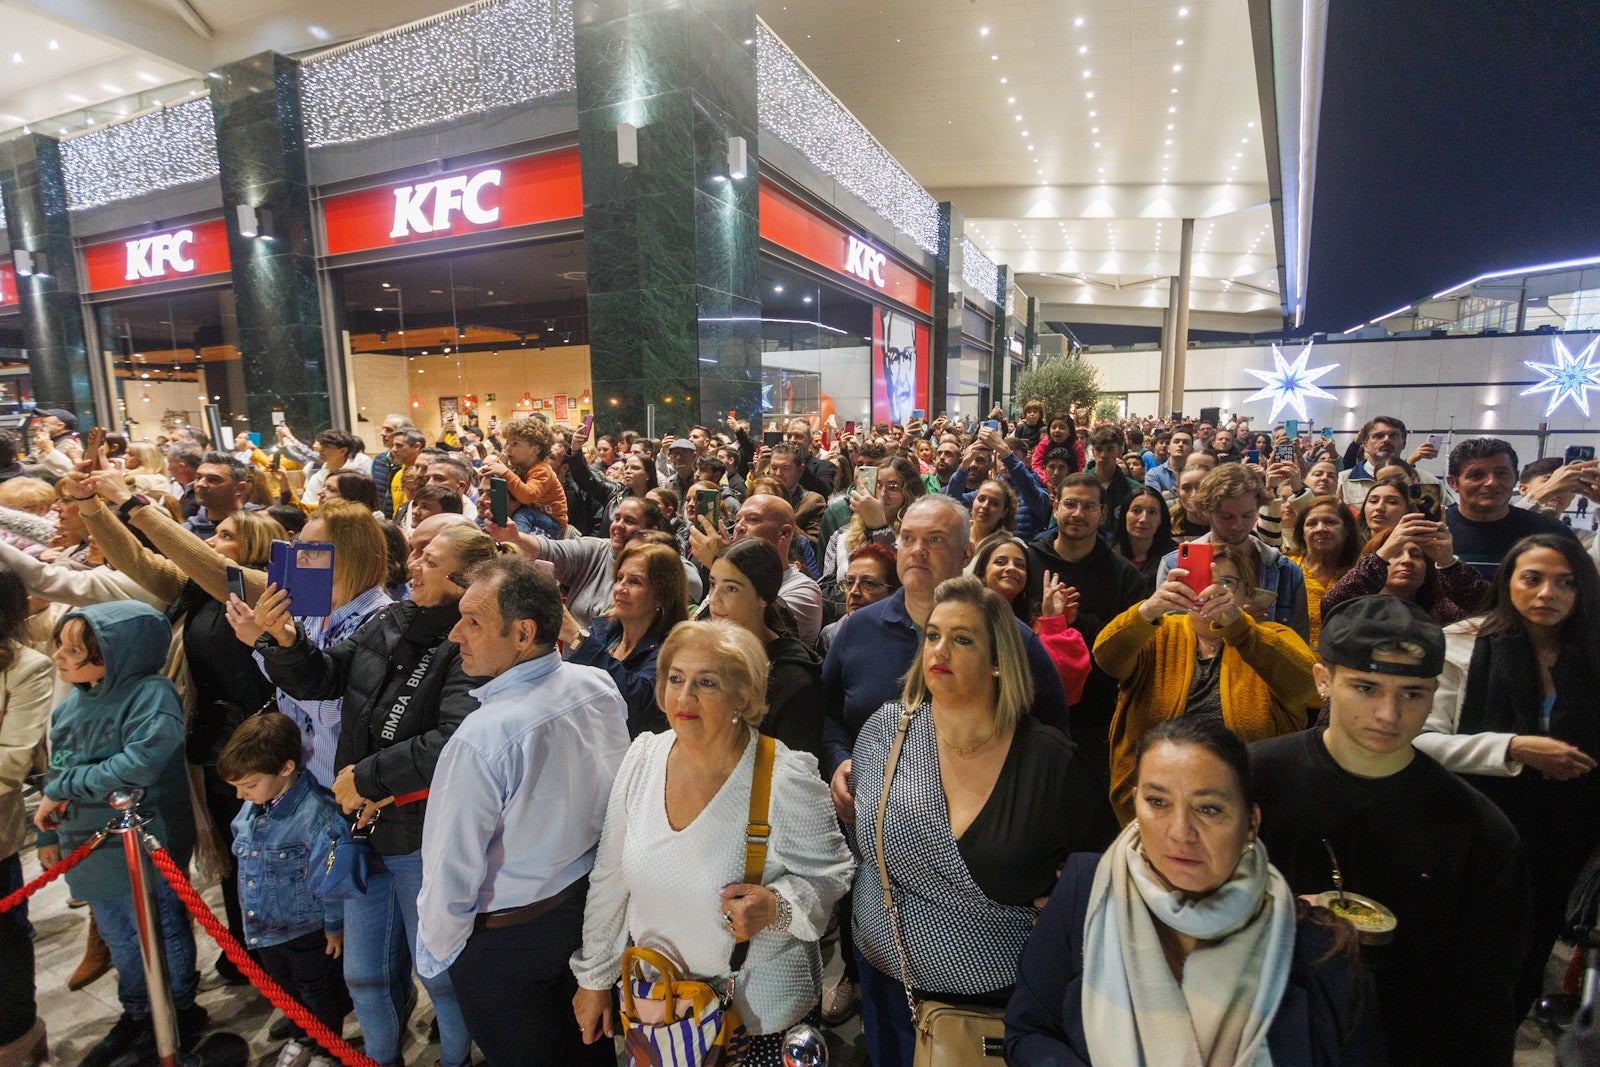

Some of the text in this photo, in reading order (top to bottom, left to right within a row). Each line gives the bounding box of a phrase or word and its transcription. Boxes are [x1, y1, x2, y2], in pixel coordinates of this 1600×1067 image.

[389, 169, 501, 238] KFC
[125, 230, 194, 280] KFC
[845, 235, 886, 287] KFC
[381, 695, 411, 740] BIMBA
